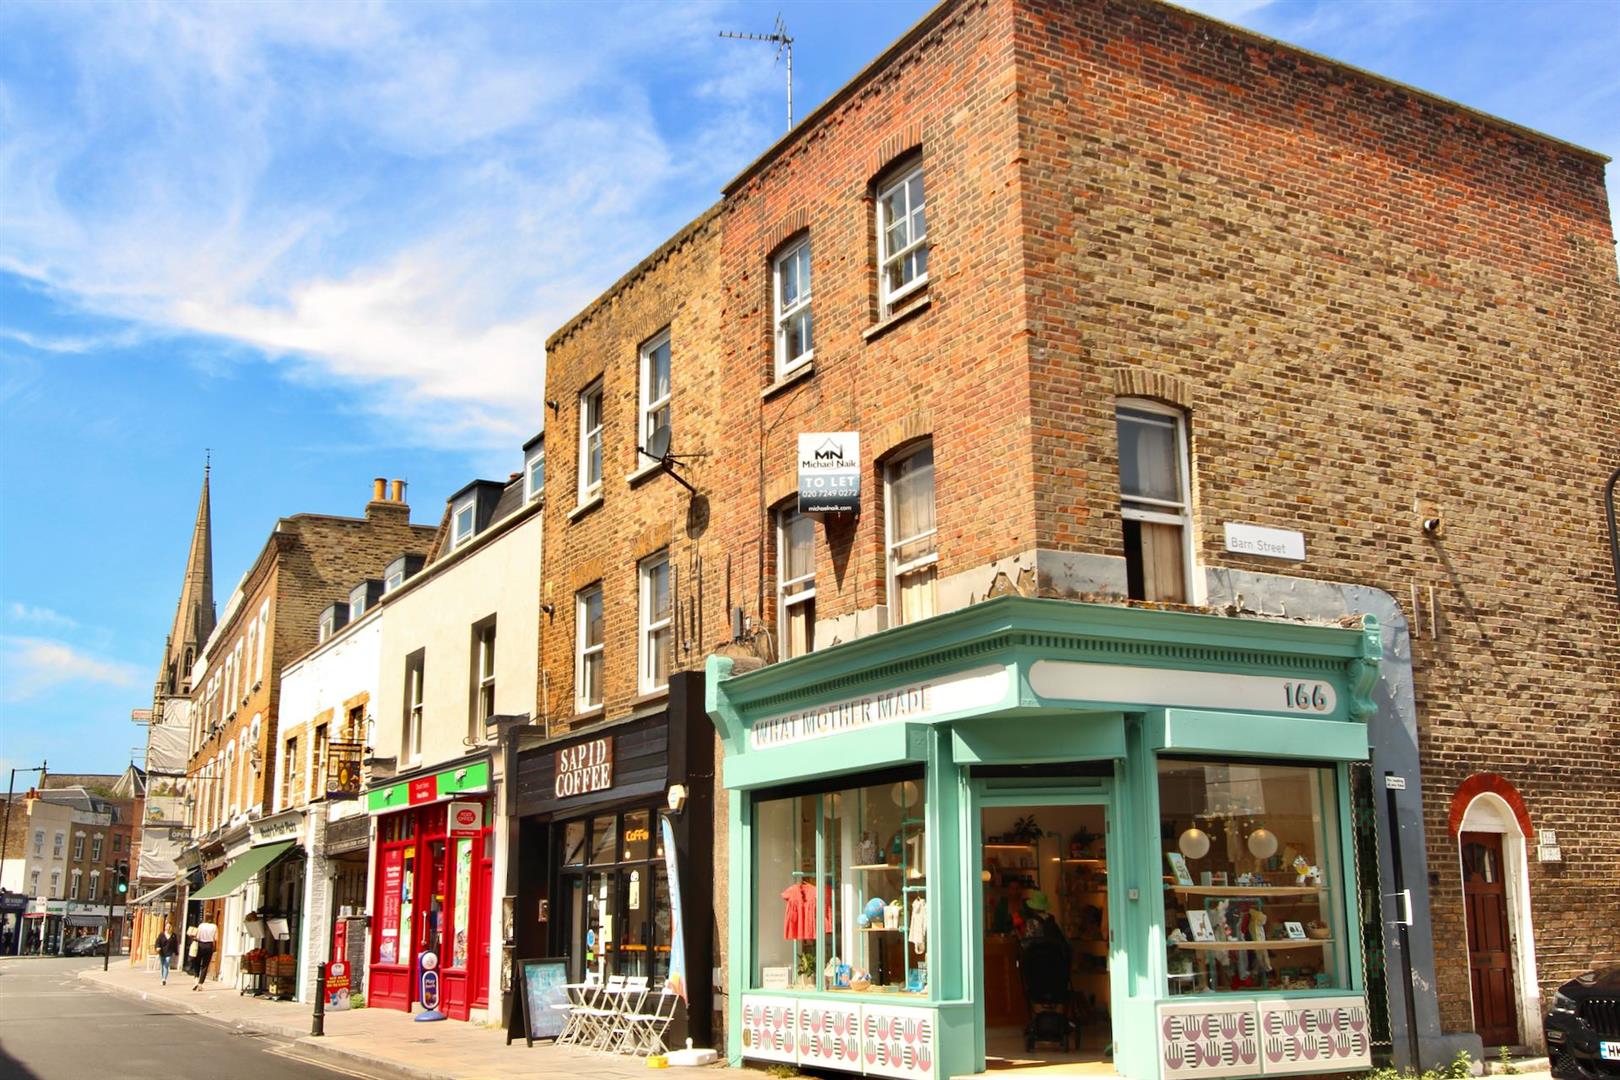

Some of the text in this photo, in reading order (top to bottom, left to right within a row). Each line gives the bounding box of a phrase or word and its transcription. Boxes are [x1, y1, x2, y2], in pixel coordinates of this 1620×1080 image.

[814, 444, 843, 460] MN
[802, 460, 856, 468] Michael Naik
[804, 476, 855, 488] TO LET
[802, 489, 817, 498] 020
[1231, 536, 1287, 554] Barn Street
[1283, 681, 1328, 711] 166
[755, 684, 932, 745] WHAT MOTHER MADE
[560, 739, 606, 773] SAPID
[555, 763, 610, 798] COFFEE
